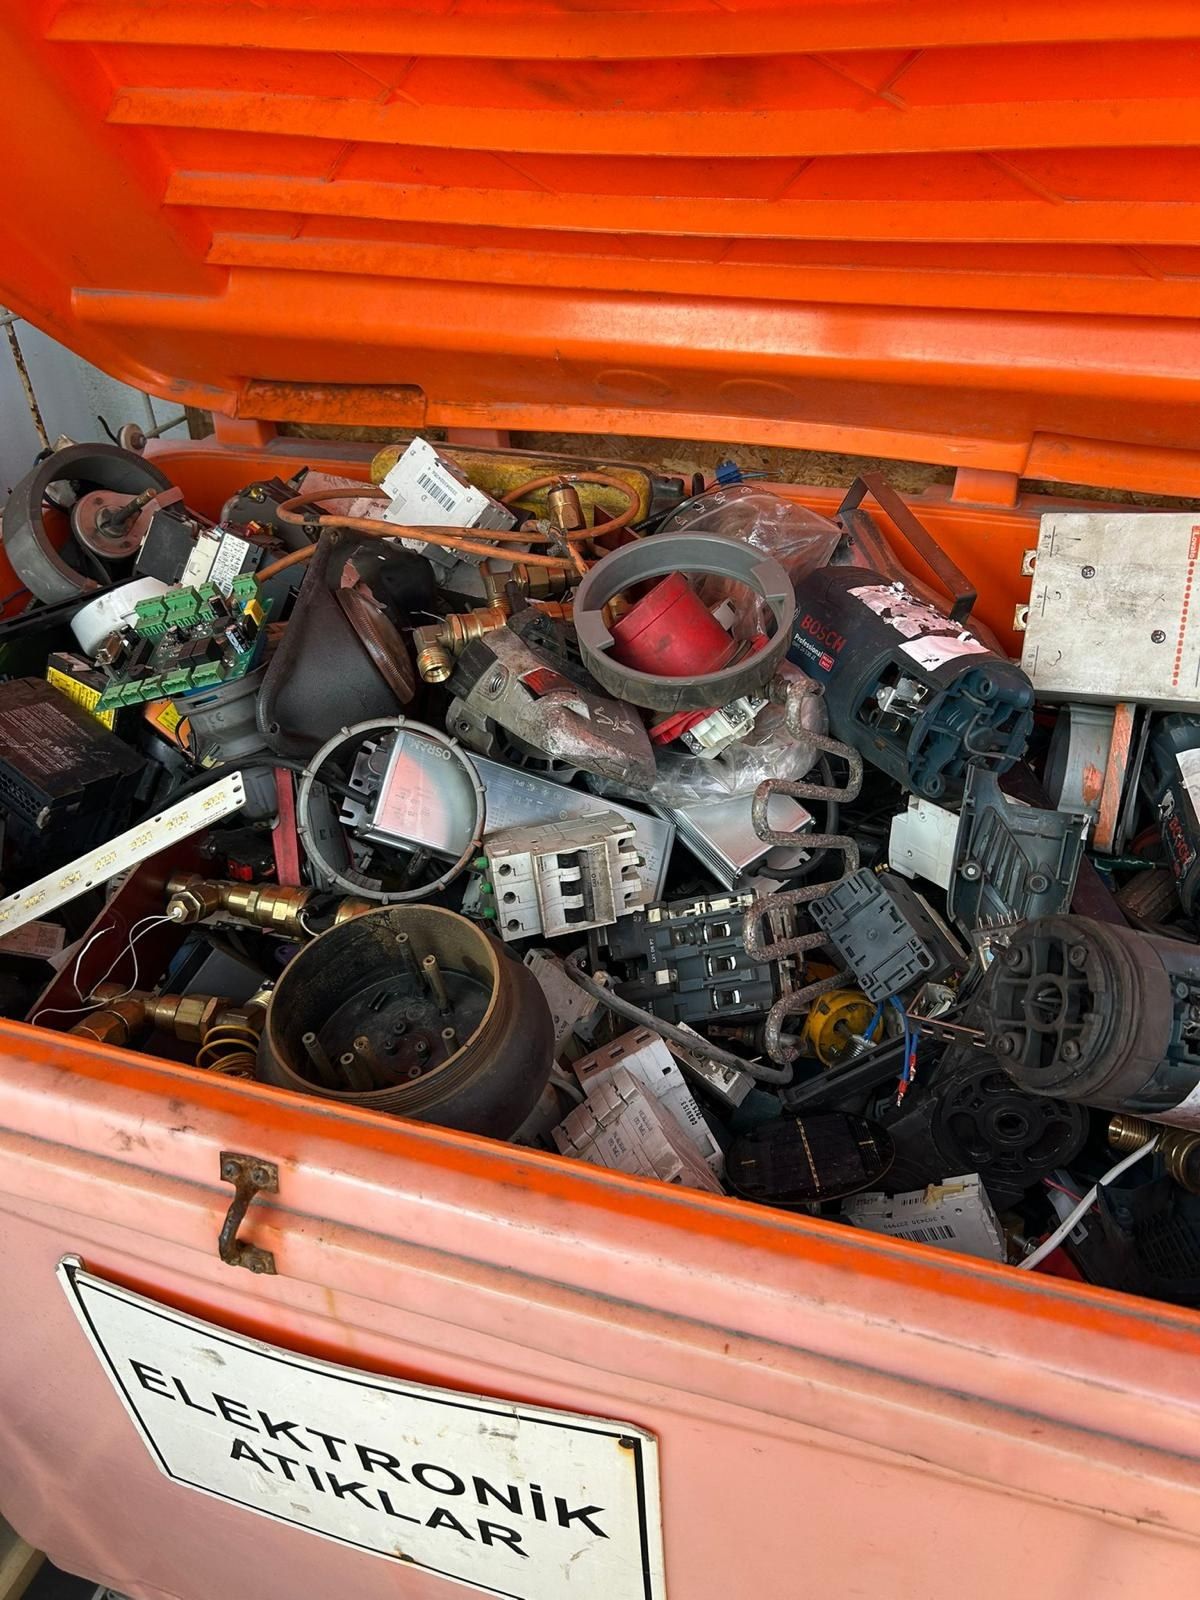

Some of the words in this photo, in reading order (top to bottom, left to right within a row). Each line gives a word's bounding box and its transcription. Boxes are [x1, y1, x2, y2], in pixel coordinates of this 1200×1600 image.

[793, 632, 825, 658] Professional
[800, 613, 849, 654] BOSCH
[229, 1438, 530, 1558] ATIKLAR
